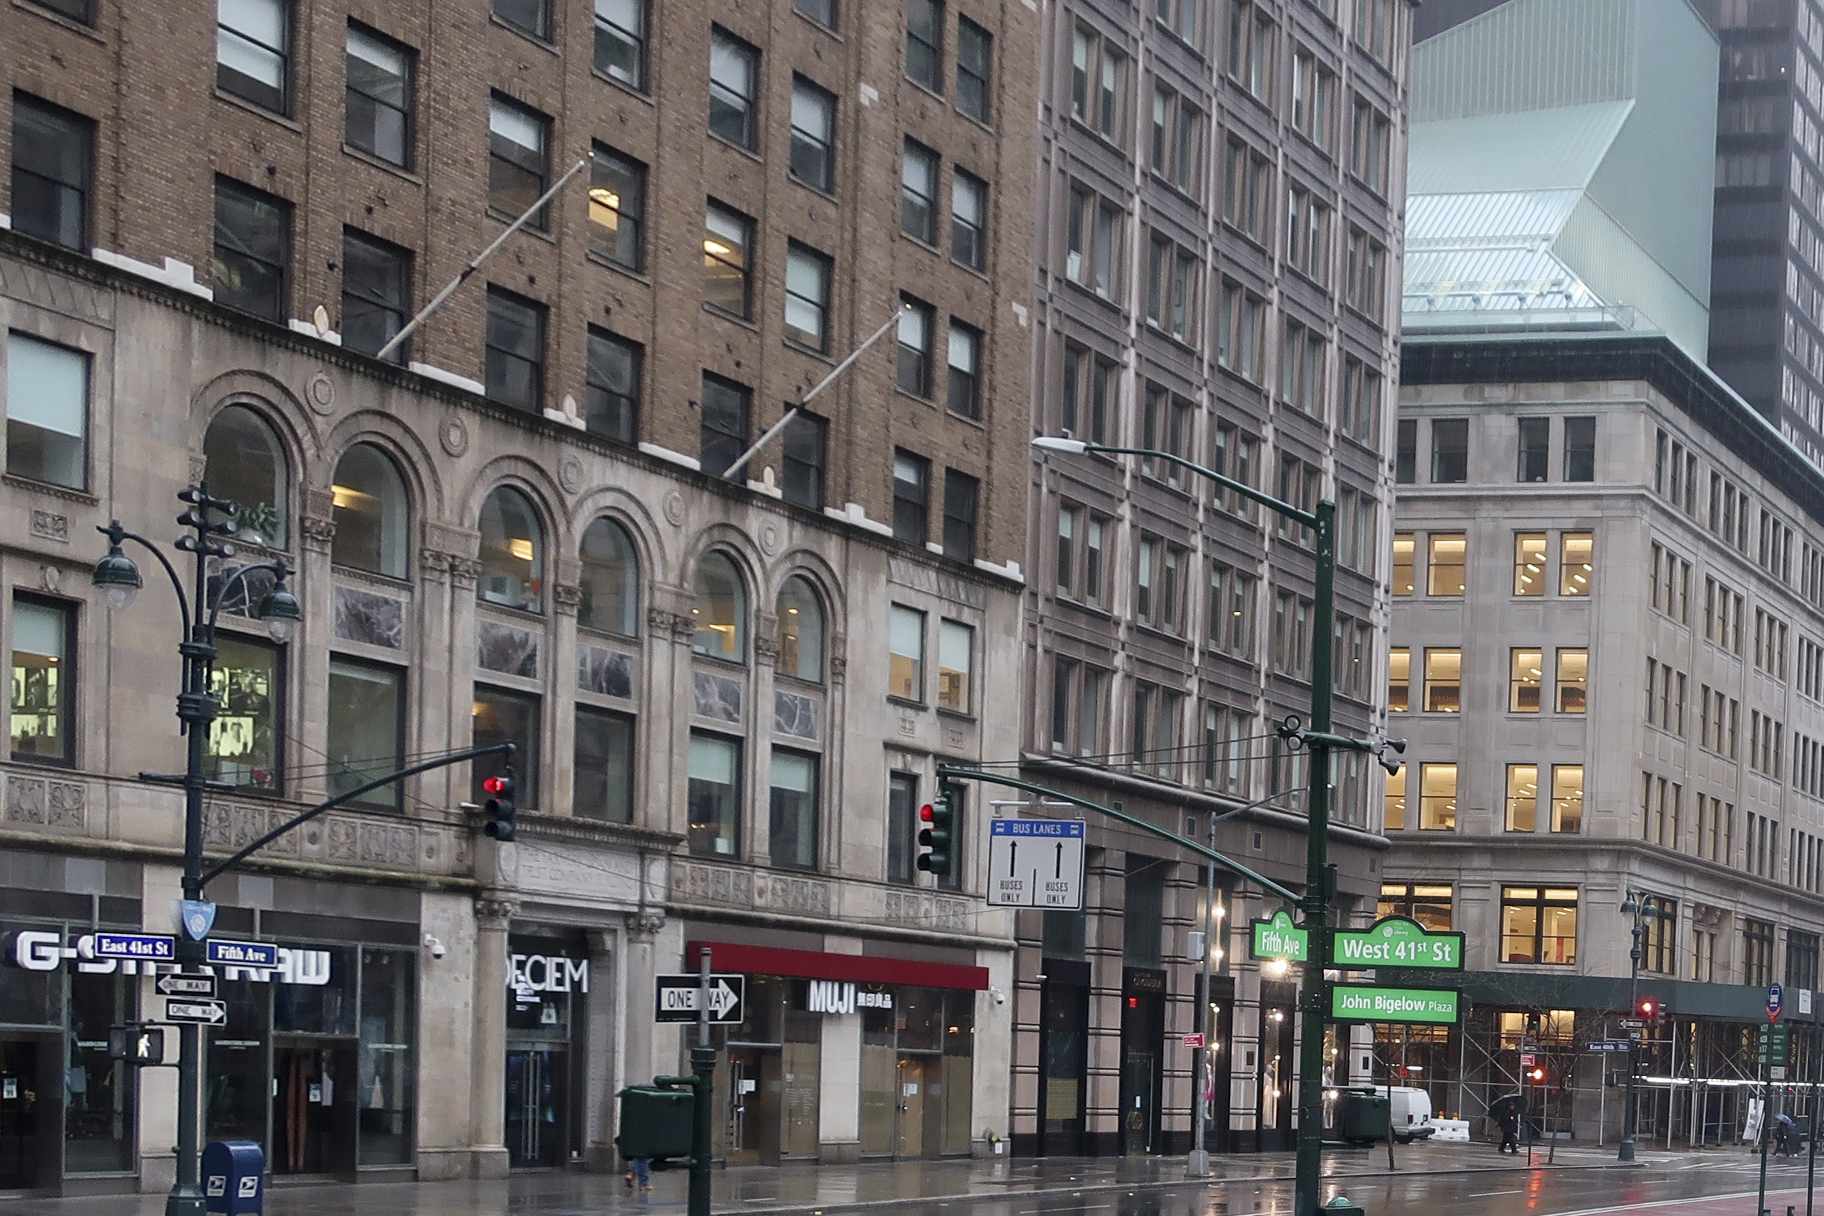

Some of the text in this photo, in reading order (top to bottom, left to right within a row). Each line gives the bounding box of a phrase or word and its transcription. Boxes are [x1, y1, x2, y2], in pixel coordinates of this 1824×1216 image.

[1012, 823, 1061, 834] BUS LANES
[1000, 880, 1023, 890] BUSES
[1045, 881, 1069, 892] BUSES
[1001, 892, 1021, 903] ONLY
[1046, 894, 1066, 904] ONLY
[101, 938, 169, 956] East 41st St
[1261, 930, 1300, 955] Fifth Ave
[217, 944, 267, 962] Fifth Ave
[1343, 939, 1452, 962] West 41st St
[162, 980, 207, 990] ONE WAY
[667, 990, 693, 1008] ONE
[809, 980, 855, 1014] MUJI
[1341, 994, 1453, 1014] John Bigelow Plaza
[171, 1005, 218, 1017] ONE WAY
